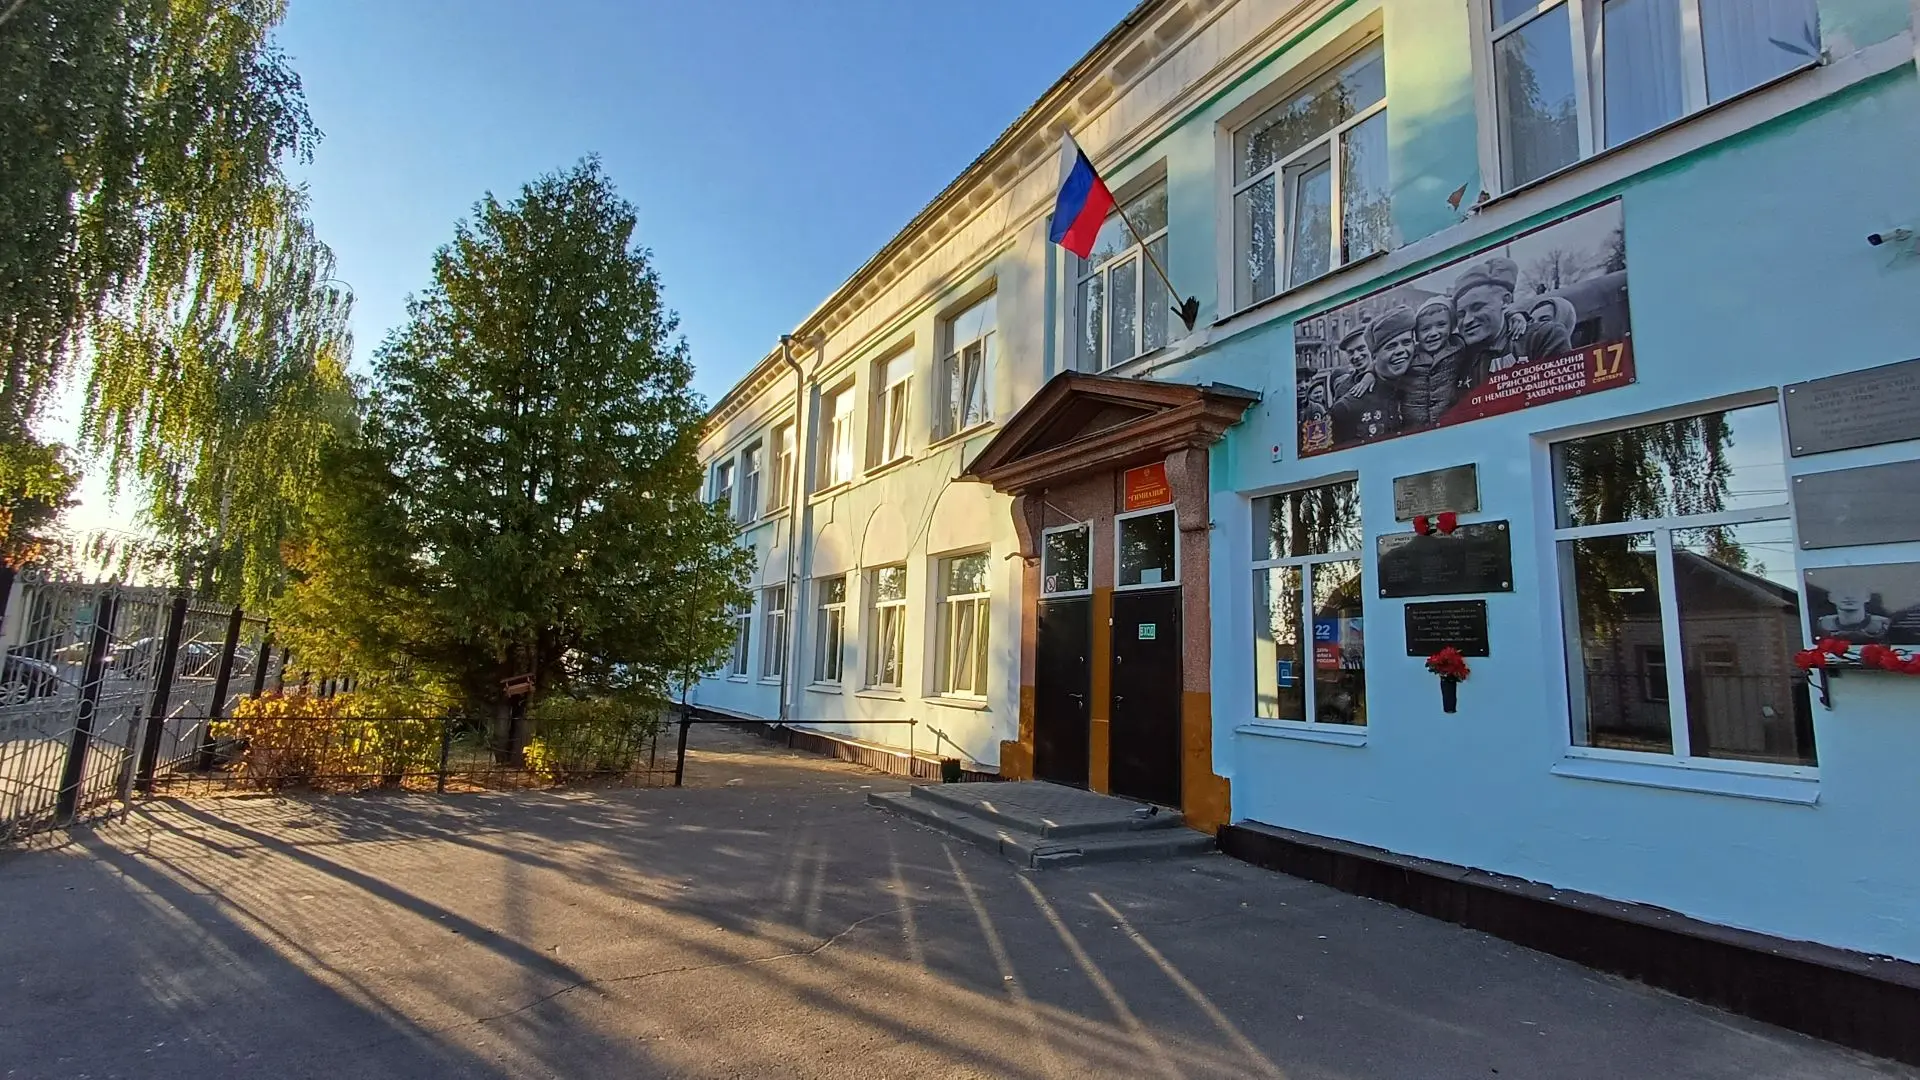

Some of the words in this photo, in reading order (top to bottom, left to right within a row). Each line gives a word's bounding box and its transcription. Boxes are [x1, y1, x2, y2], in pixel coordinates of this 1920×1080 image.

[1488, 374, 1509, 385] ДЕНЬ
[1511, 353, 1584, 379] ОСВОБОЖДЕНИЯ
[1592, 343, 1624, 377] 17
[1471, 397, 1482, 405] ОТ
[1485, 371, 1586, 402] НЕМЕЦКО-ФАШИСТСКИХ
[1496, 373, 1541, 391] БРЯНСКОЙ
[1543, 361, 1585, 379] ОБЛАСТИ
[1526, 380, 1586, 400] ЗАХВАТЧИКОВ
[1139, 626, 1155, 637] ВХОД
[1315, 624, 1331, 635] 22
